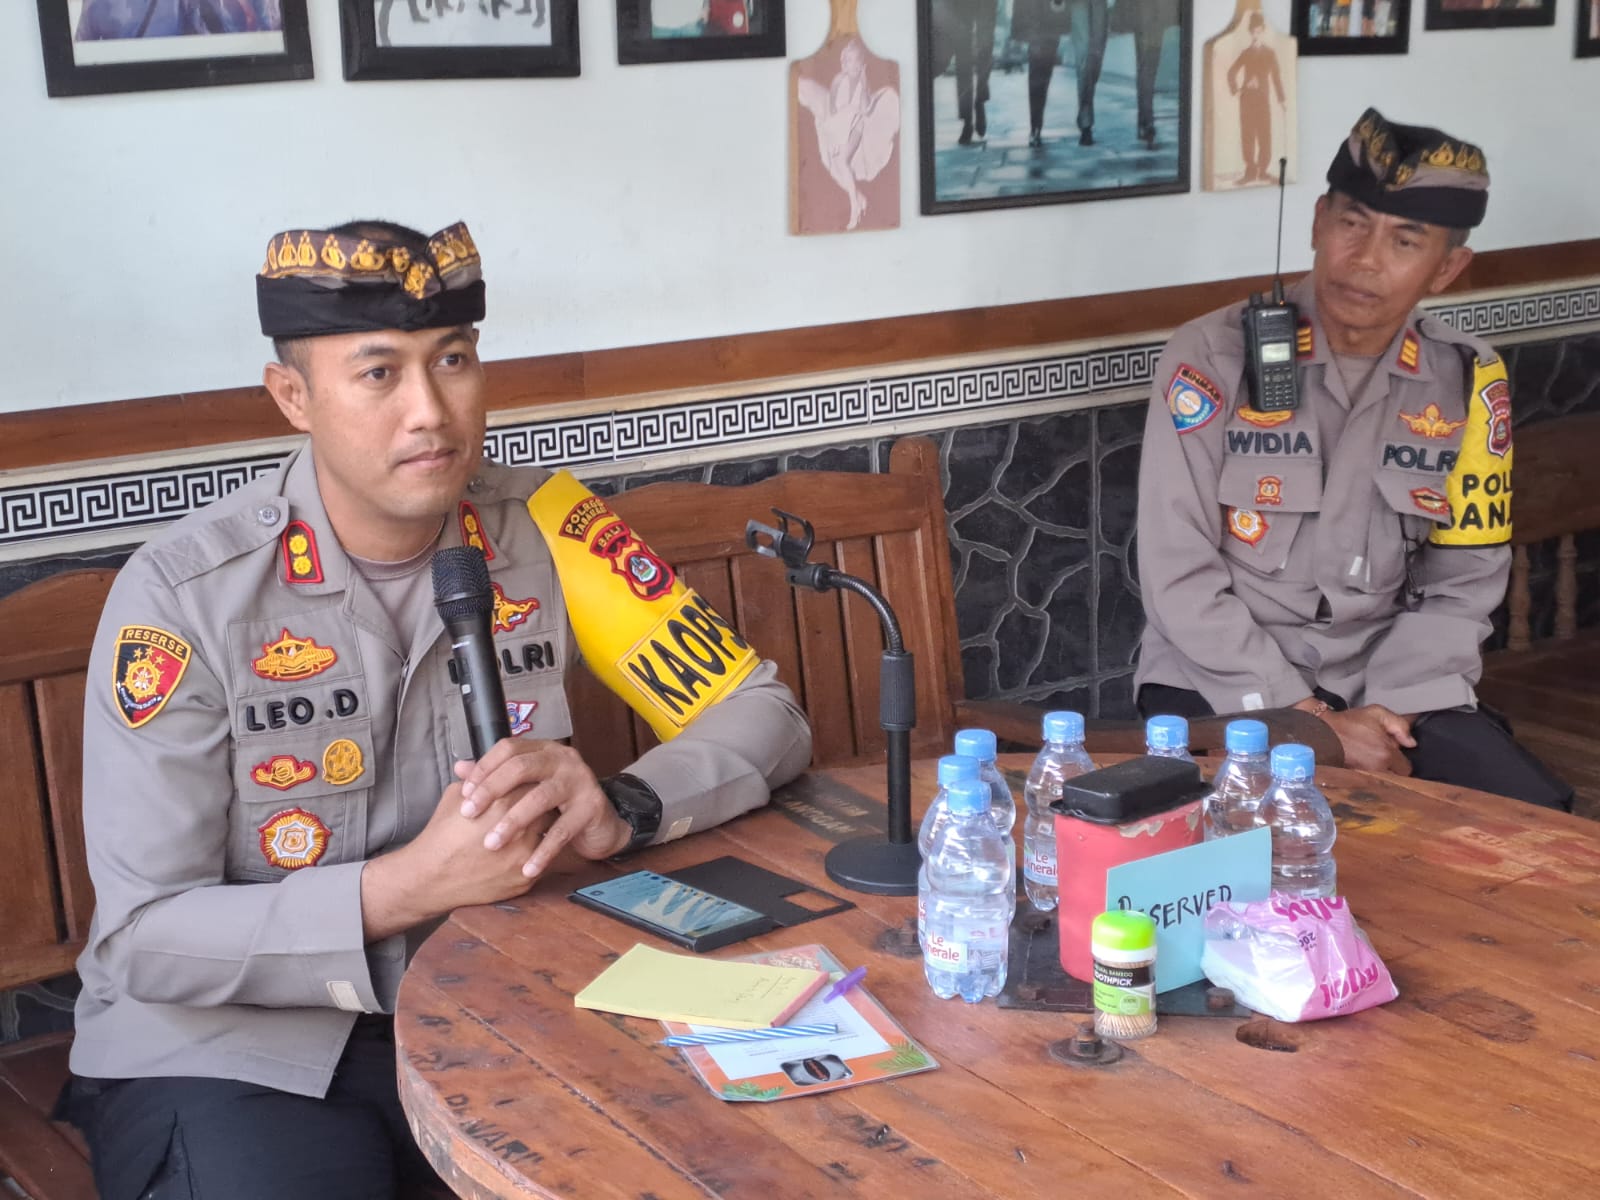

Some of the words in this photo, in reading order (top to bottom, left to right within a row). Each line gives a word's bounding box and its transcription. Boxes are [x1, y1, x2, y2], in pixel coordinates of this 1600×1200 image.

[1228, 430, 1313, 455] WIDIA
[1382, 443, 1460, 473] POLR
[1462, 470, 1512, 499] POL
[125, 628, 185, 655] RESERSE
[627, 595, 750, 716] KAOPS
[447, 641, 555, 685] LRI
[1035, 849, 1049, 864] Le
[1118, 884, 1232, 929] RSERVED
[931, 929, 945, 947] Le
[1094, 970, 1133, 987] OOTHPICK
